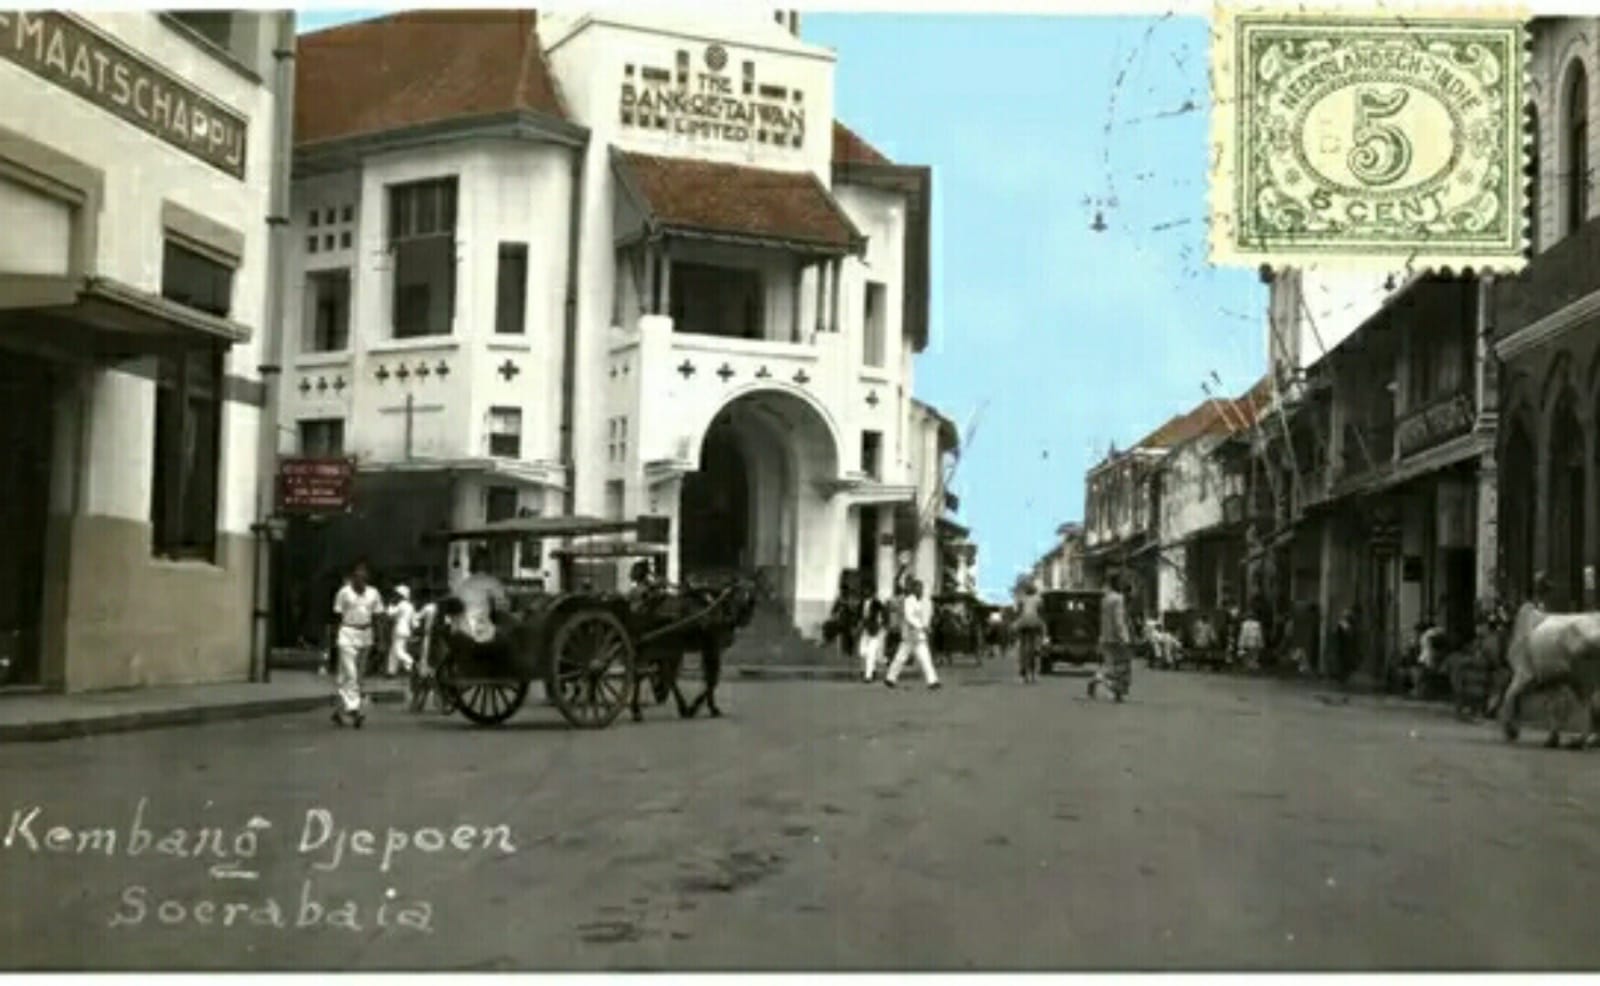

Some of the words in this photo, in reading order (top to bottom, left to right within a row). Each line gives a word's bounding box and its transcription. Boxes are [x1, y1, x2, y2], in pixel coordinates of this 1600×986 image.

[698, 73, 732, 94] THE
[674, 118, 749, 142] LIMITED
[1347, 87, 1413, 187] 5
[1346, 190, 1445, 223] CENT
